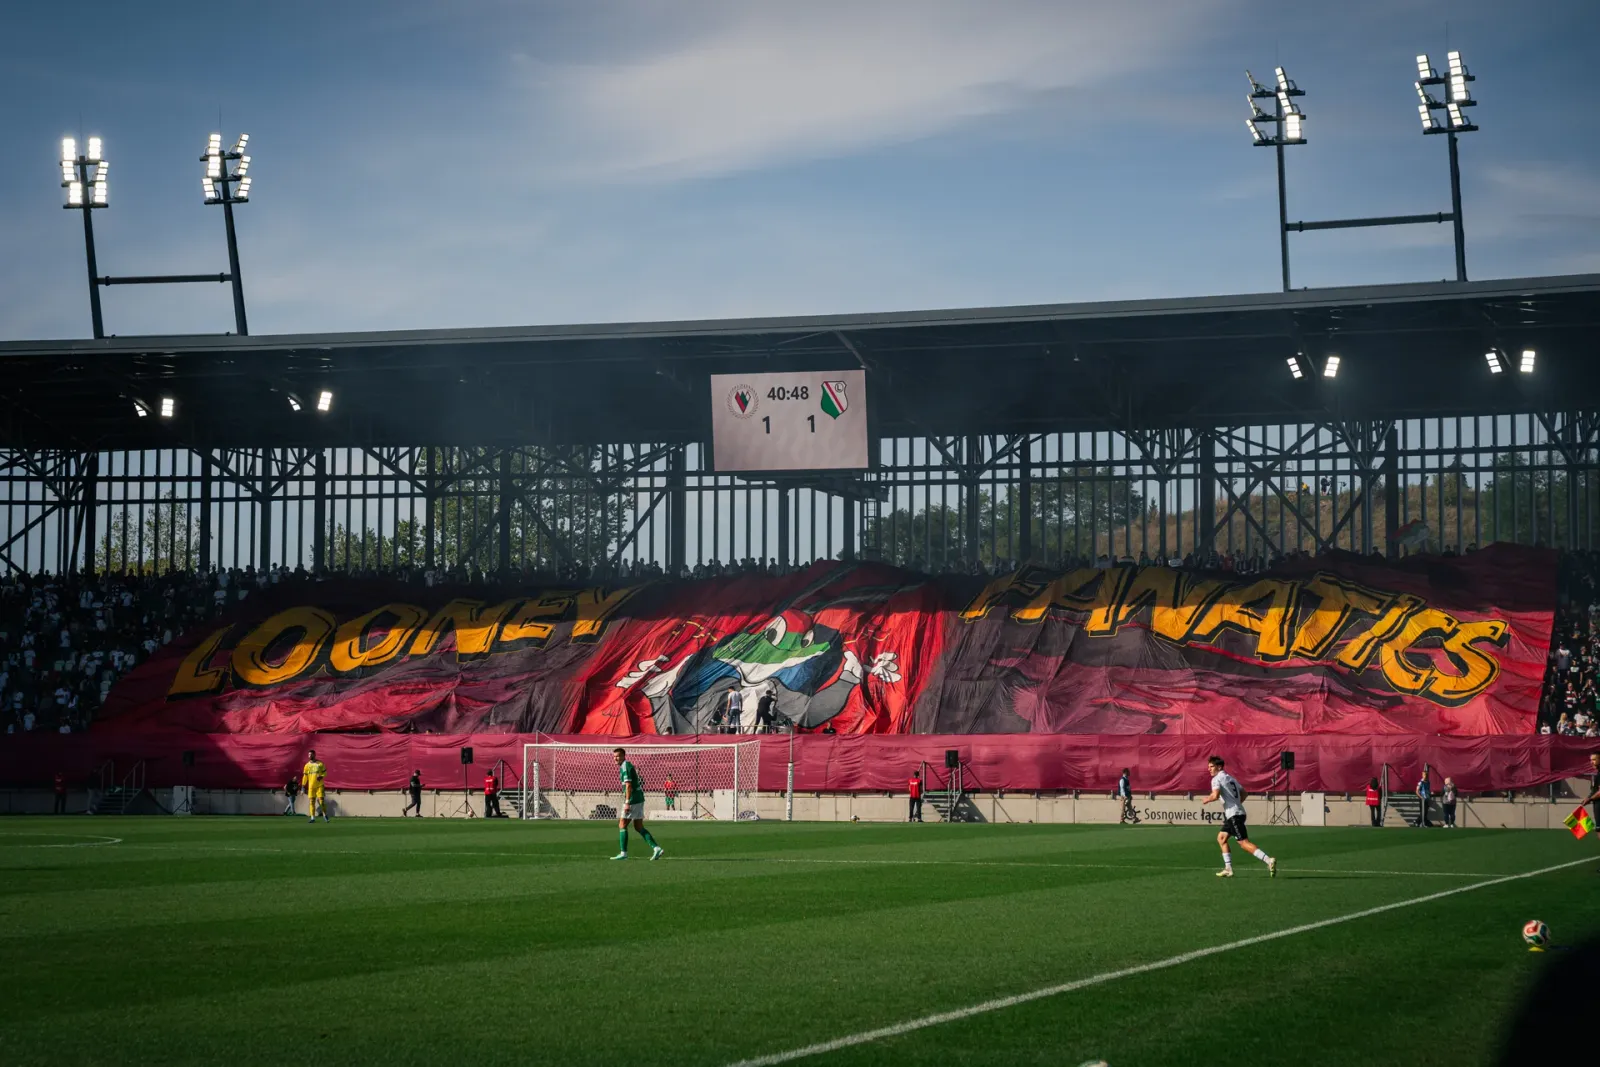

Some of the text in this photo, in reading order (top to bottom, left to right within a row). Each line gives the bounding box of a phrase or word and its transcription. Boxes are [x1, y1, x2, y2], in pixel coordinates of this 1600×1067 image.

[767, 386, 809, 401] 40:48
[762, 416, 771, 434] 1
[807, 415, 815, 433] 1
[167, 567, 1508, 708] LOONEY FANATICS
[1144, 808, 1198, 821] Sosnowiec
